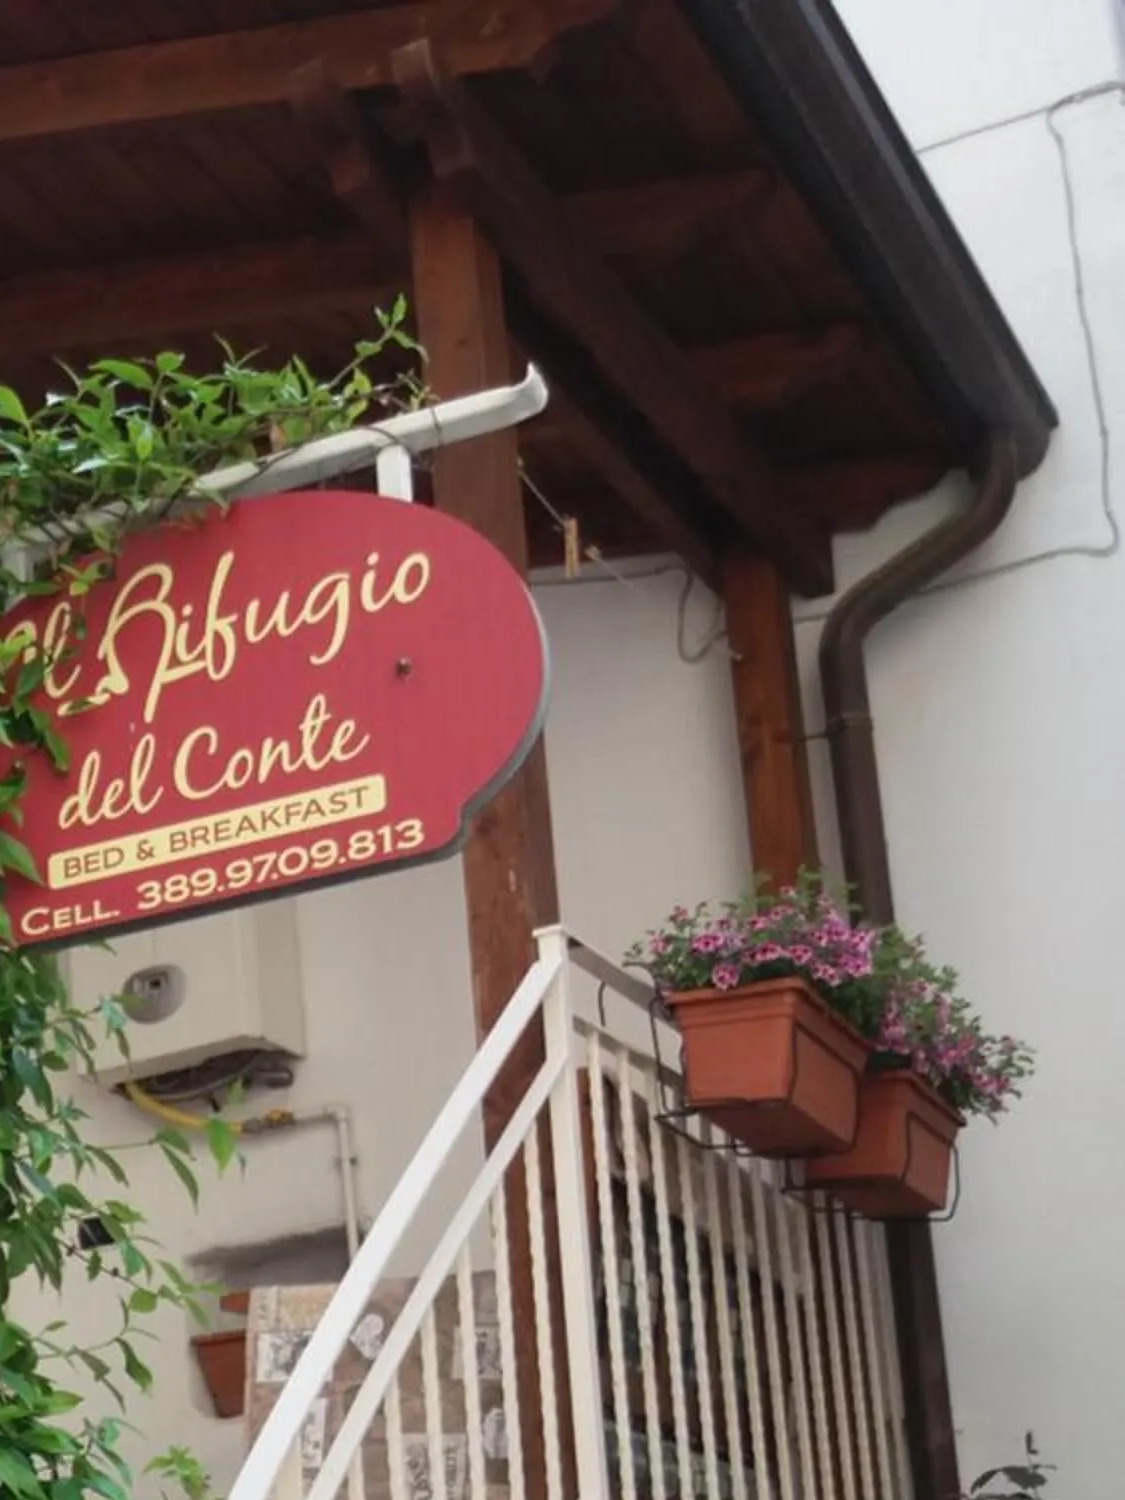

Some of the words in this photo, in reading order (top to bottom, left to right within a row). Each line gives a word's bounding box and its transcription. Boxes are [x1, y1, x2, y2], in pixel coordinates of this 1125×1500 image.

[56, 550, 432, 724] Rifugio
[58, 732, 165, 831] del
[173, 693, 371, 800] Conte
[62, 846, 125, 890] BED
[136, 838, 156, 862] &
[169, 785, 370, 854] BREAKFAST
